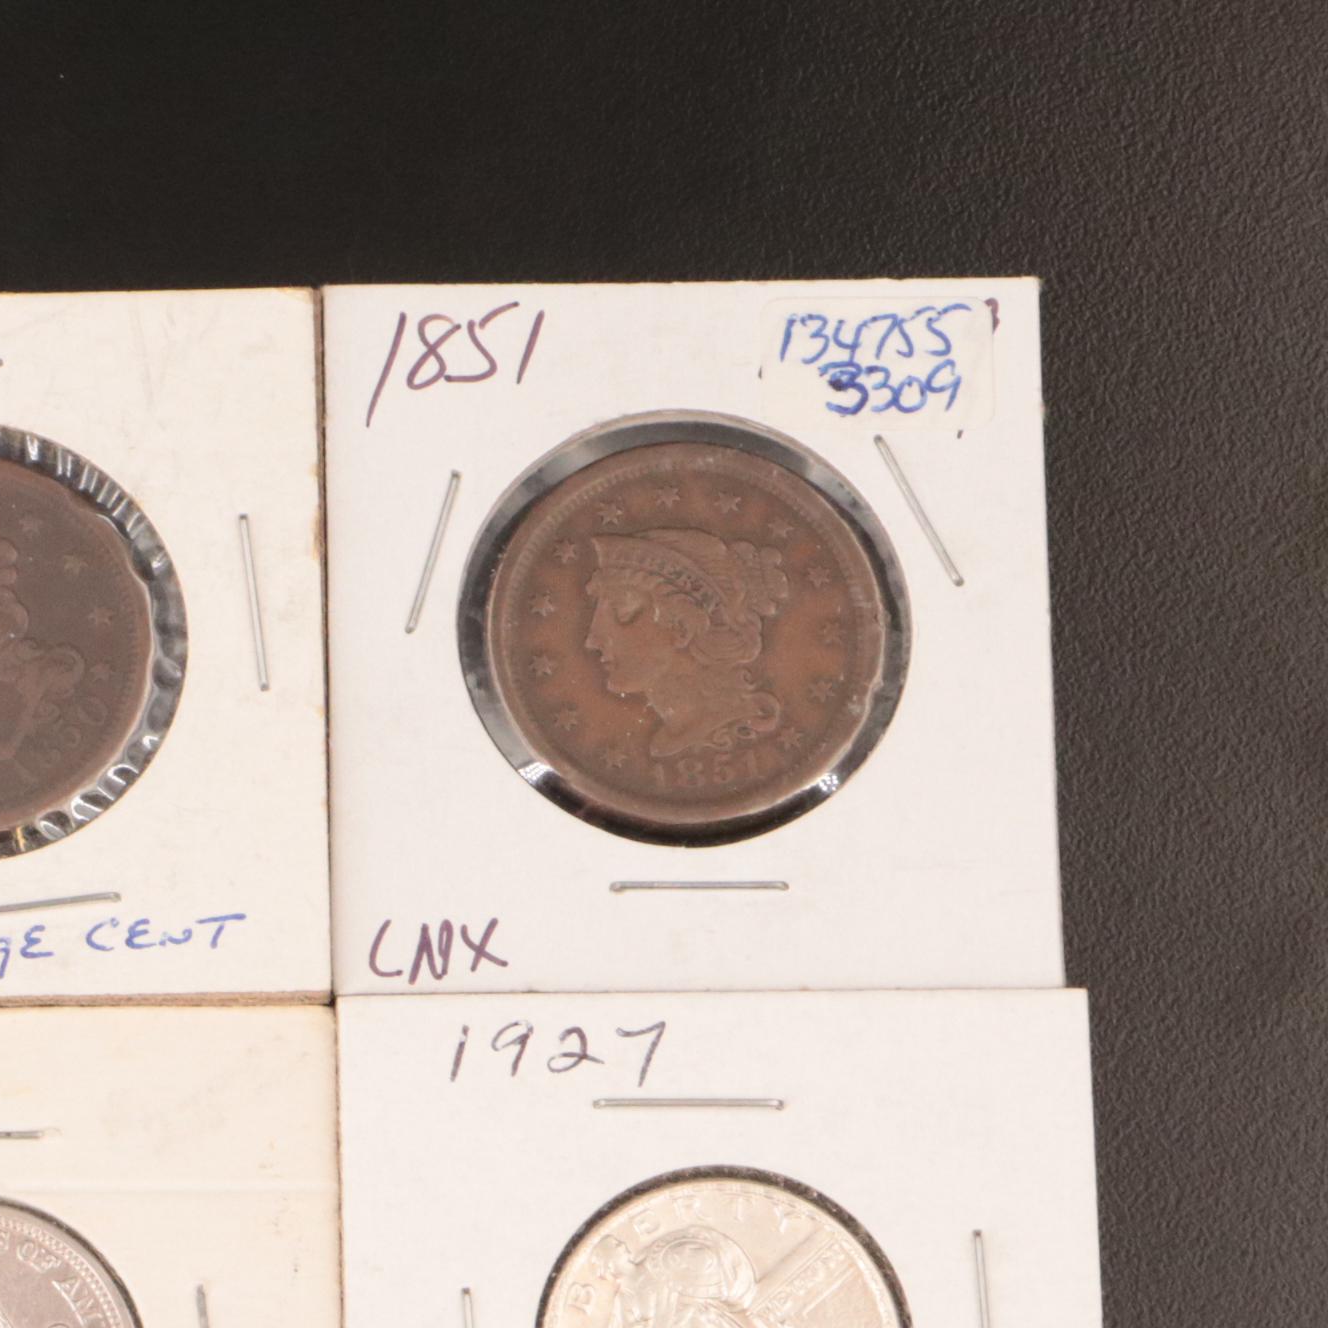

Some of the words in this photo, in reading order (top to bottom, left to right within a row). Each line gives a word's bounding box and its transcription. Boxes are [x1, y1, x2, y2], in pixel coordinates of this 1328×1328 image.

[367, 302, 546, 429] 1851
[651, 750, 766, 789] 1851
[448, 1020, 667, 1088] 1927
[15, 1239, 62, 1277] OF
